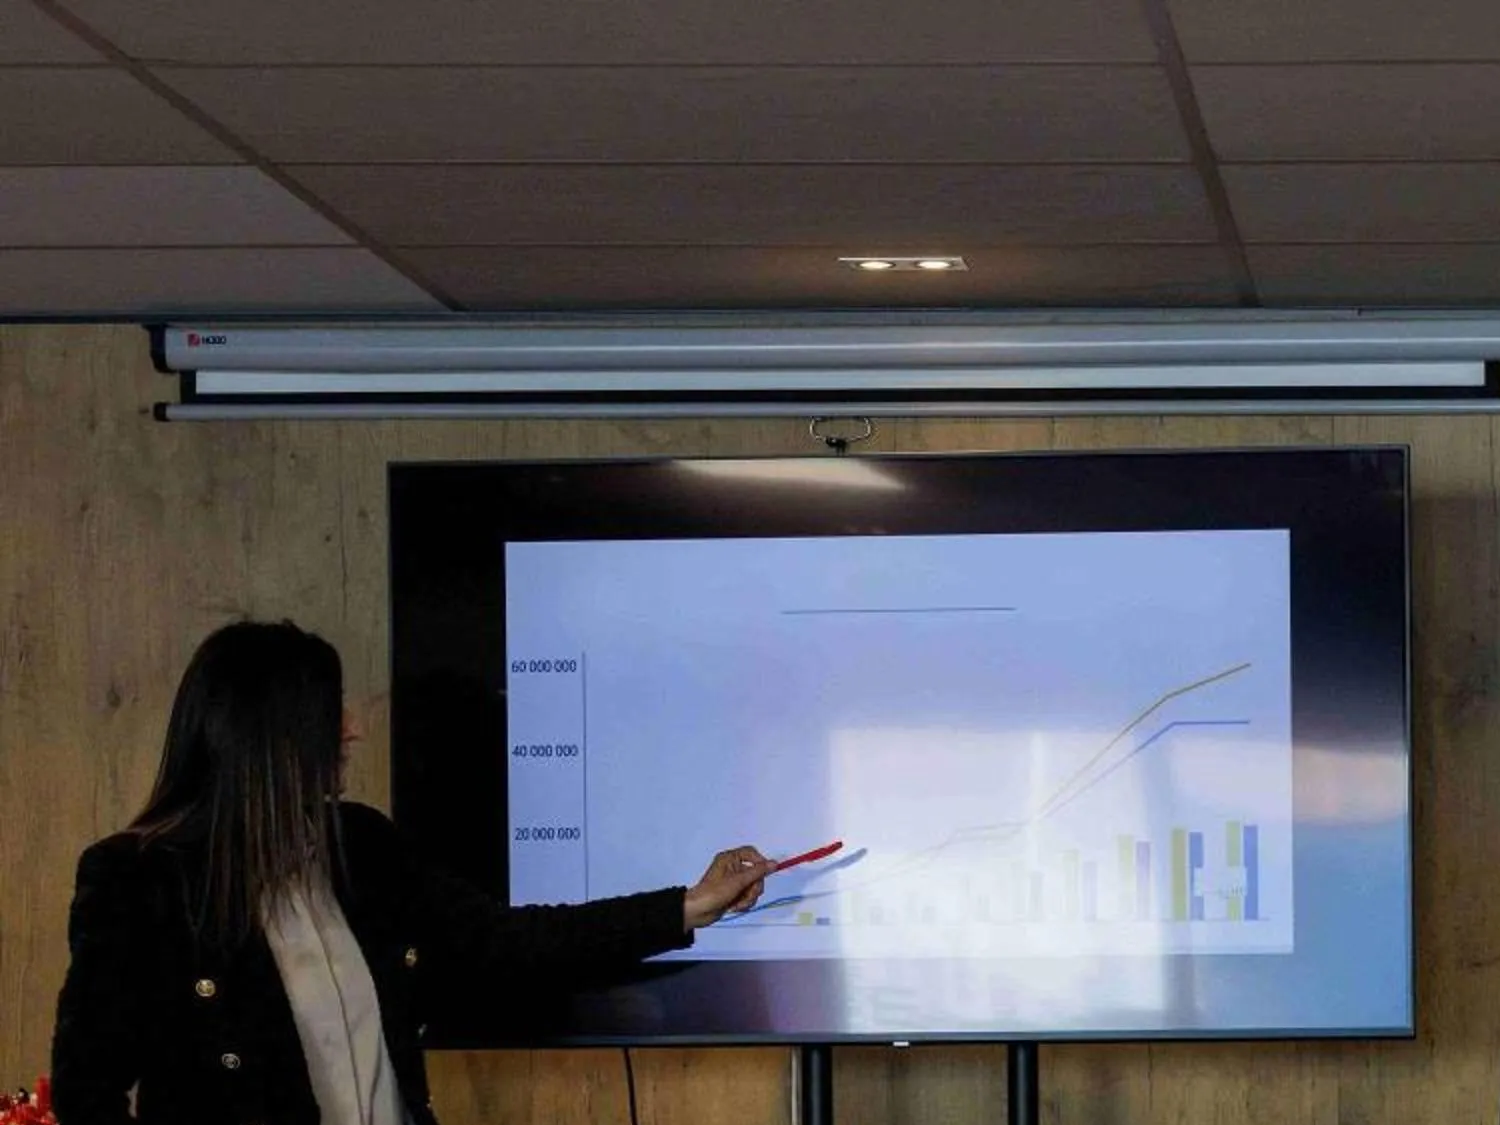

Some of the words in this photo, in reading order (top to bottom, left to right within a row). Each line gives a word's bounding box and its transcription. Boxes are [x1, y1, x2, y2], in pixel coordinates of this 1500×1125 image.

[511, 659, 527, 673] 60
[529, 659, 552, 673] 000
[554, 659, 577, 673] 000
[511, 744, 527, 757] 40
[529, 744, 552, 757] 000
[515, 827, 529, 841] 20
